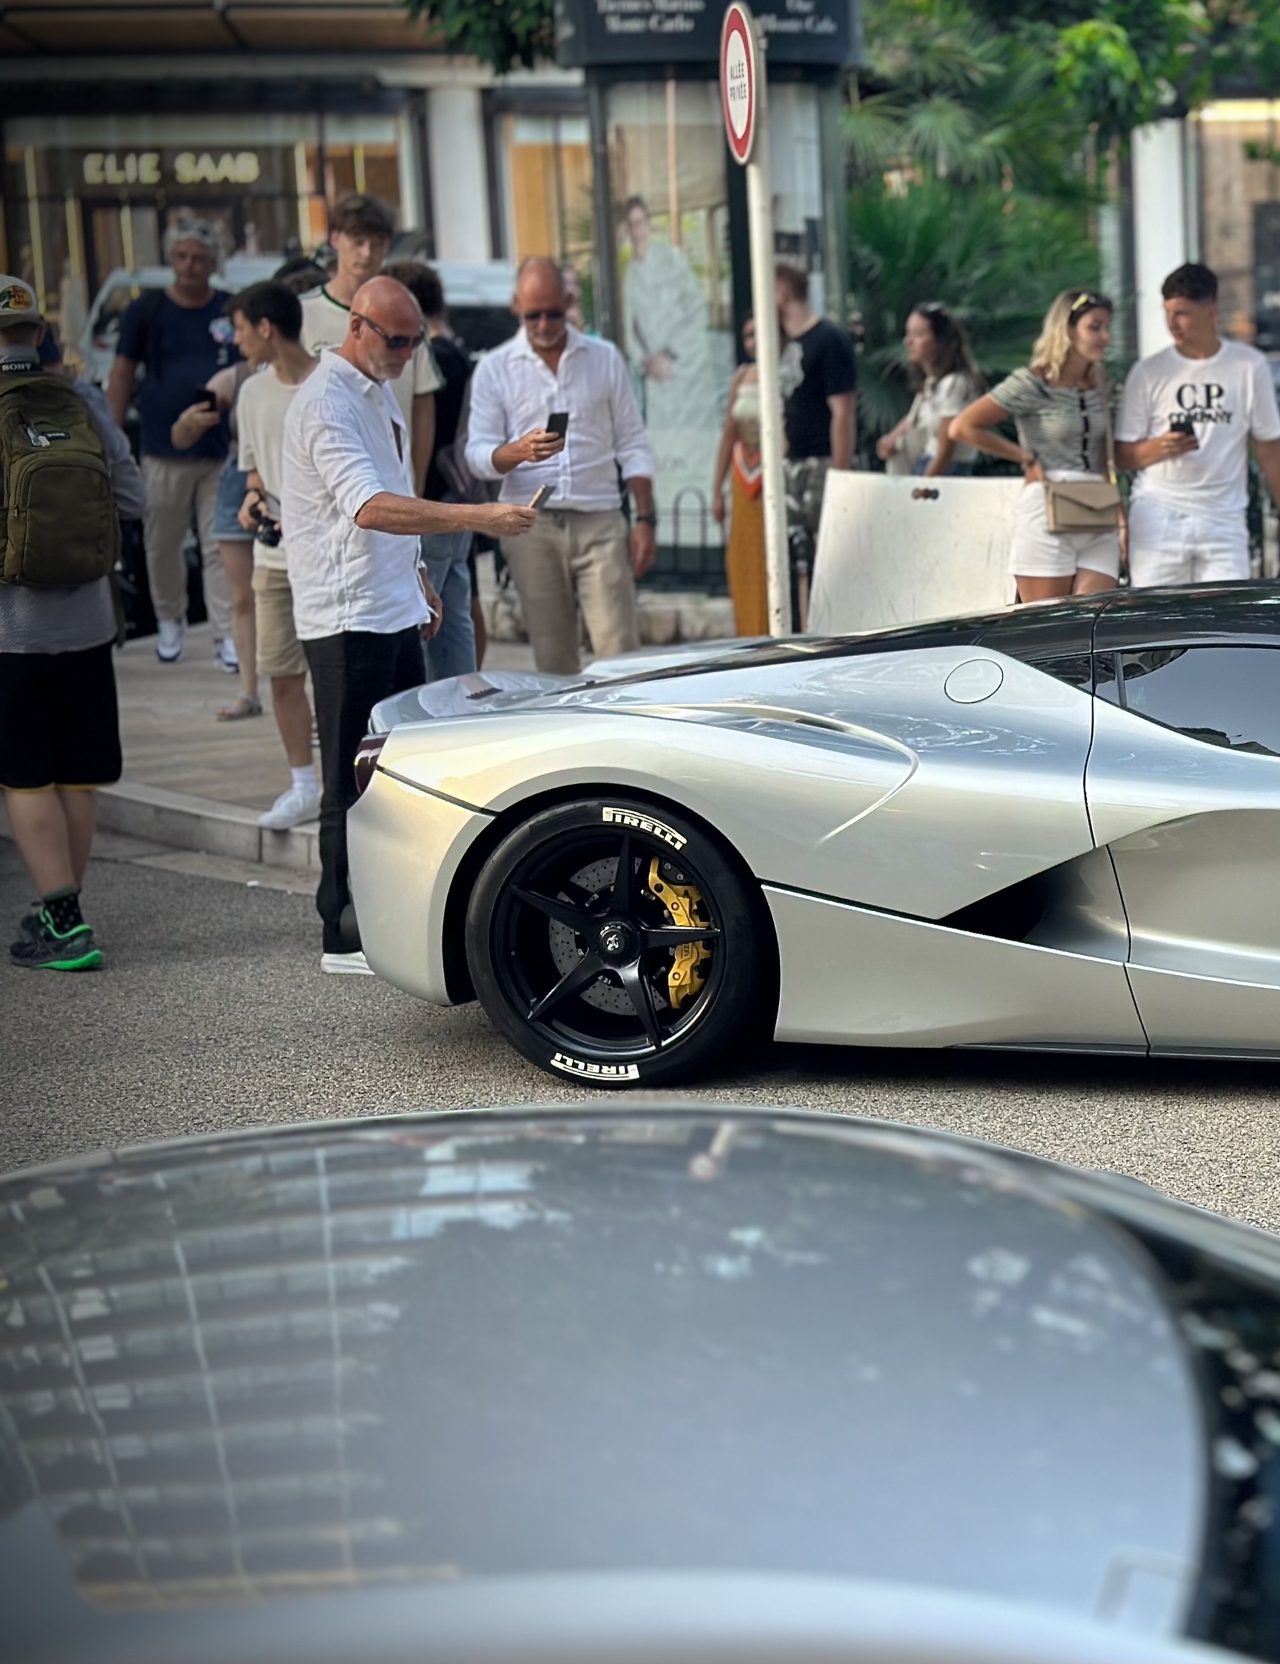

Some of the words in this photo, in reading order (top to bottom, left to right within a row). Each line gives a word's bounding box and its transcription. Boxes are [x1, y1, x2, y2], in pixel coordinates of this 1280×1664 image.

[83, 153, 161, 184] ELIE
[174, 152, 259, 184] SAAB
[2, 363, 31, 371] SONY
[602, 807, 688, 851] PIRELLI
[550, 1052, 640, 1080] PIRELLI
